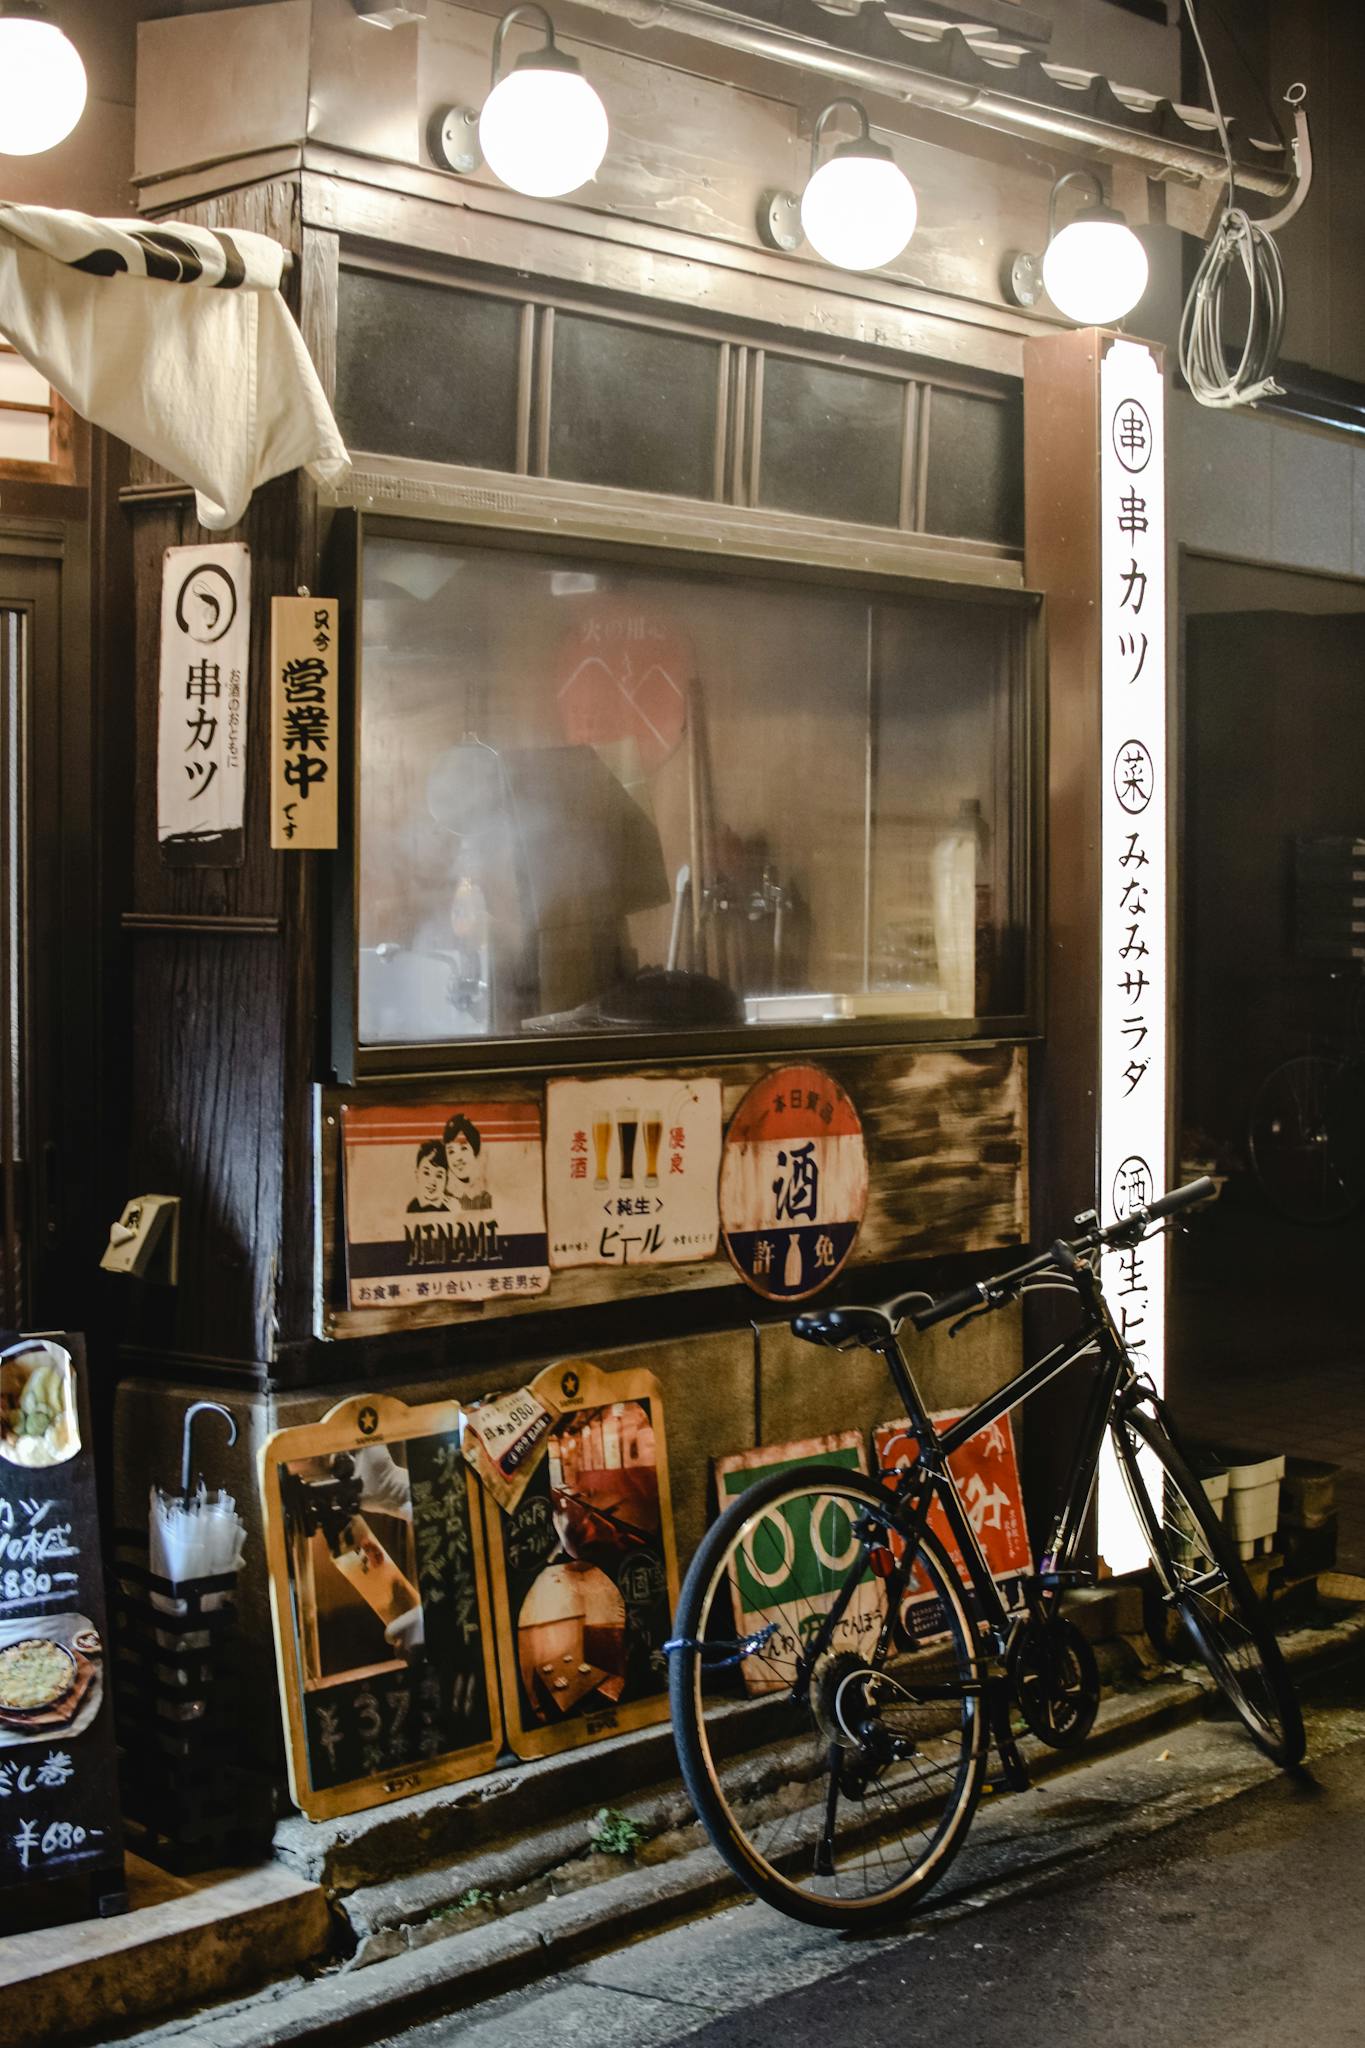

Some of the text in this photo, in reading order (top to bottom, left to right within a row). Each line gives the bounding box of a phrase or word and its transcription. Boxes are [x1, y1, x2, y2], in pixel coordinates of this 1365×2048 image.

[1118, 405, 1149, 684] 串 串カツ
[185, 658, 221, 801] 串カツ
[282, 658, 329, 799] 営業中
[1117, 746, 1151, 1098] 菜 みなみサラダ
[772, 1142, 817, 1221] 酒
[1117, 1160, 1149, 1217] 酒
[599, 1224, 663, 1265] ビール
[0, 1566, 79, 1599] 880-
